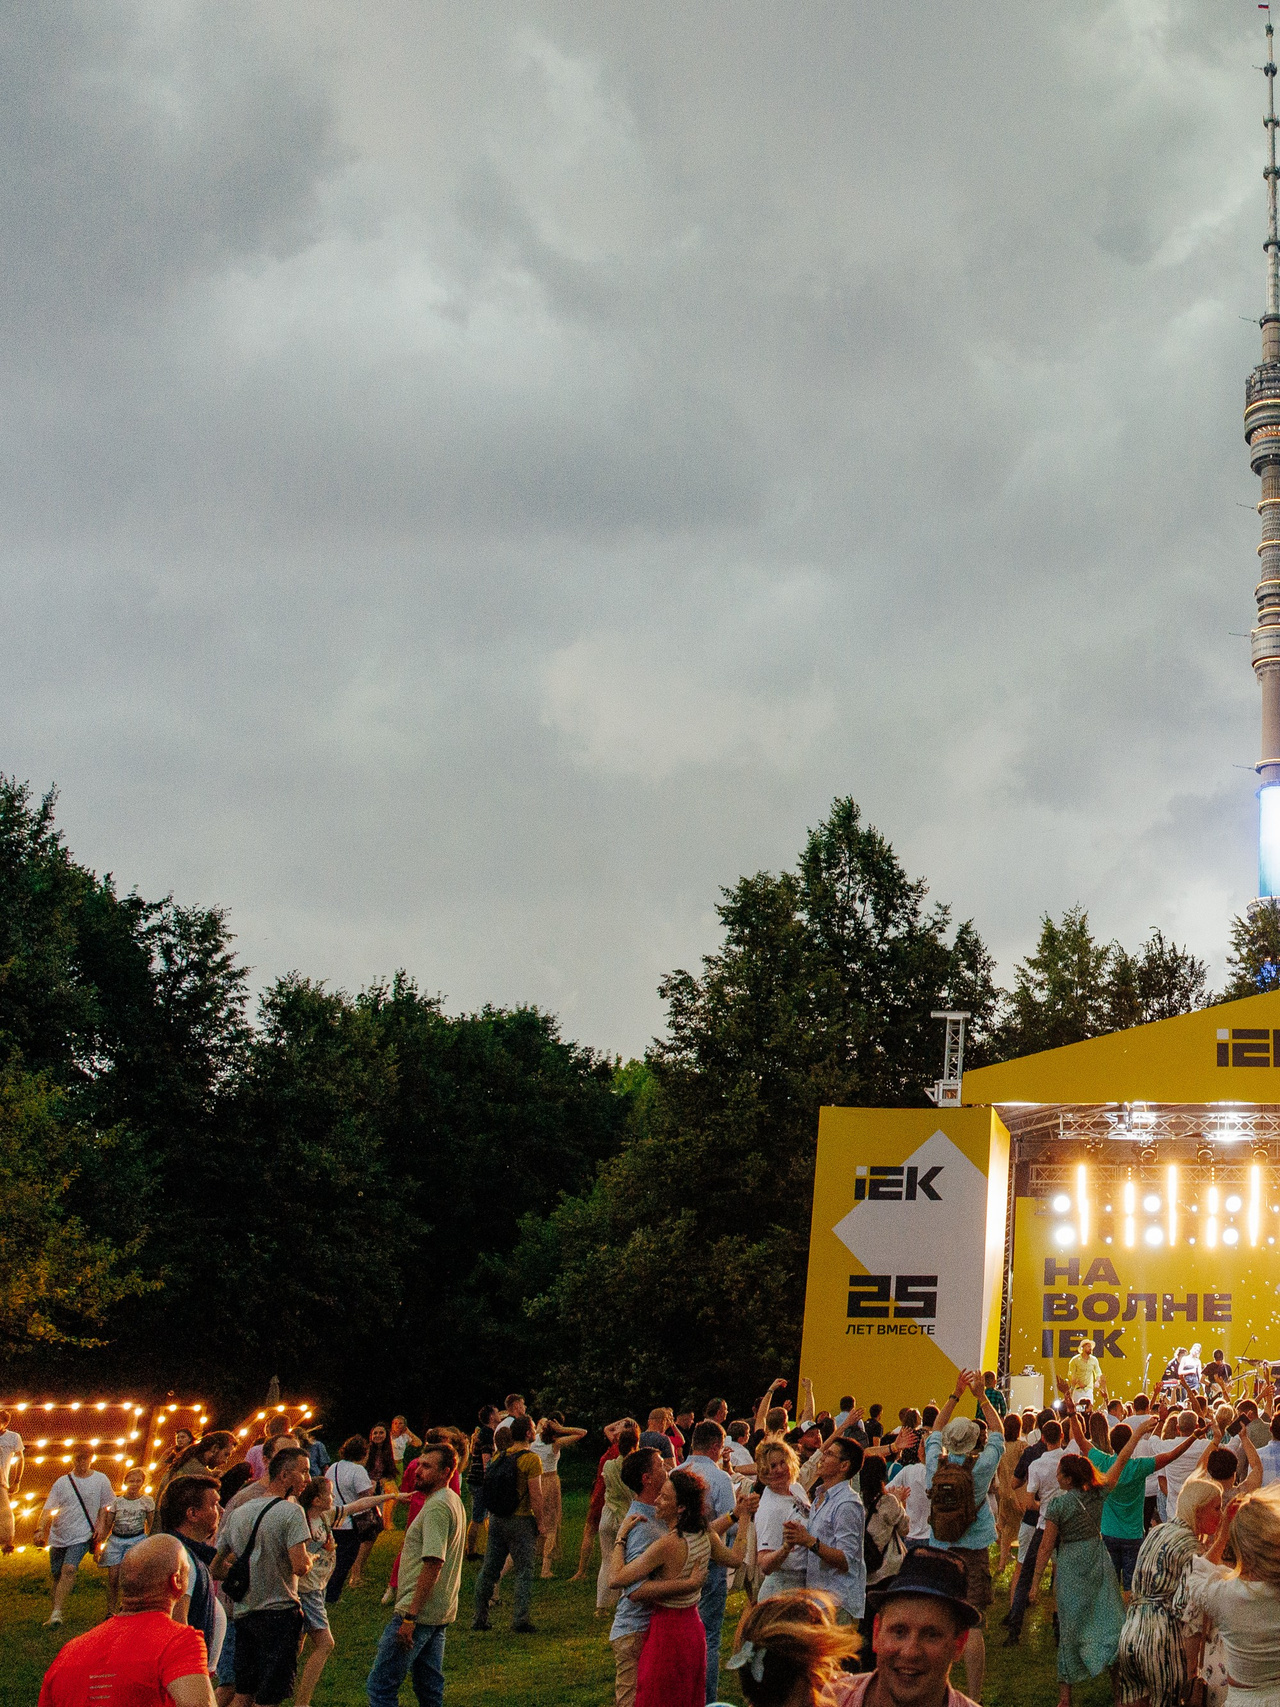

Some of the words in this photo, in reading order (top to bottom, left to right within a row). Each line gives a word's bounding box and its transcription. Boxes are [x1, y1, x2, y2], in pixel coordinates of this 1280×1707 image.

[1043, 1257, 1122, 1287] НА
[846, 1274, 939, 1319] 25
[1042, 1292, 1233, 1323] ВОЛНЕ
[845, 1324, 875, 1336] ЛЕТ
[876, 1324, 936, 1336] ВМЕСТЕ
